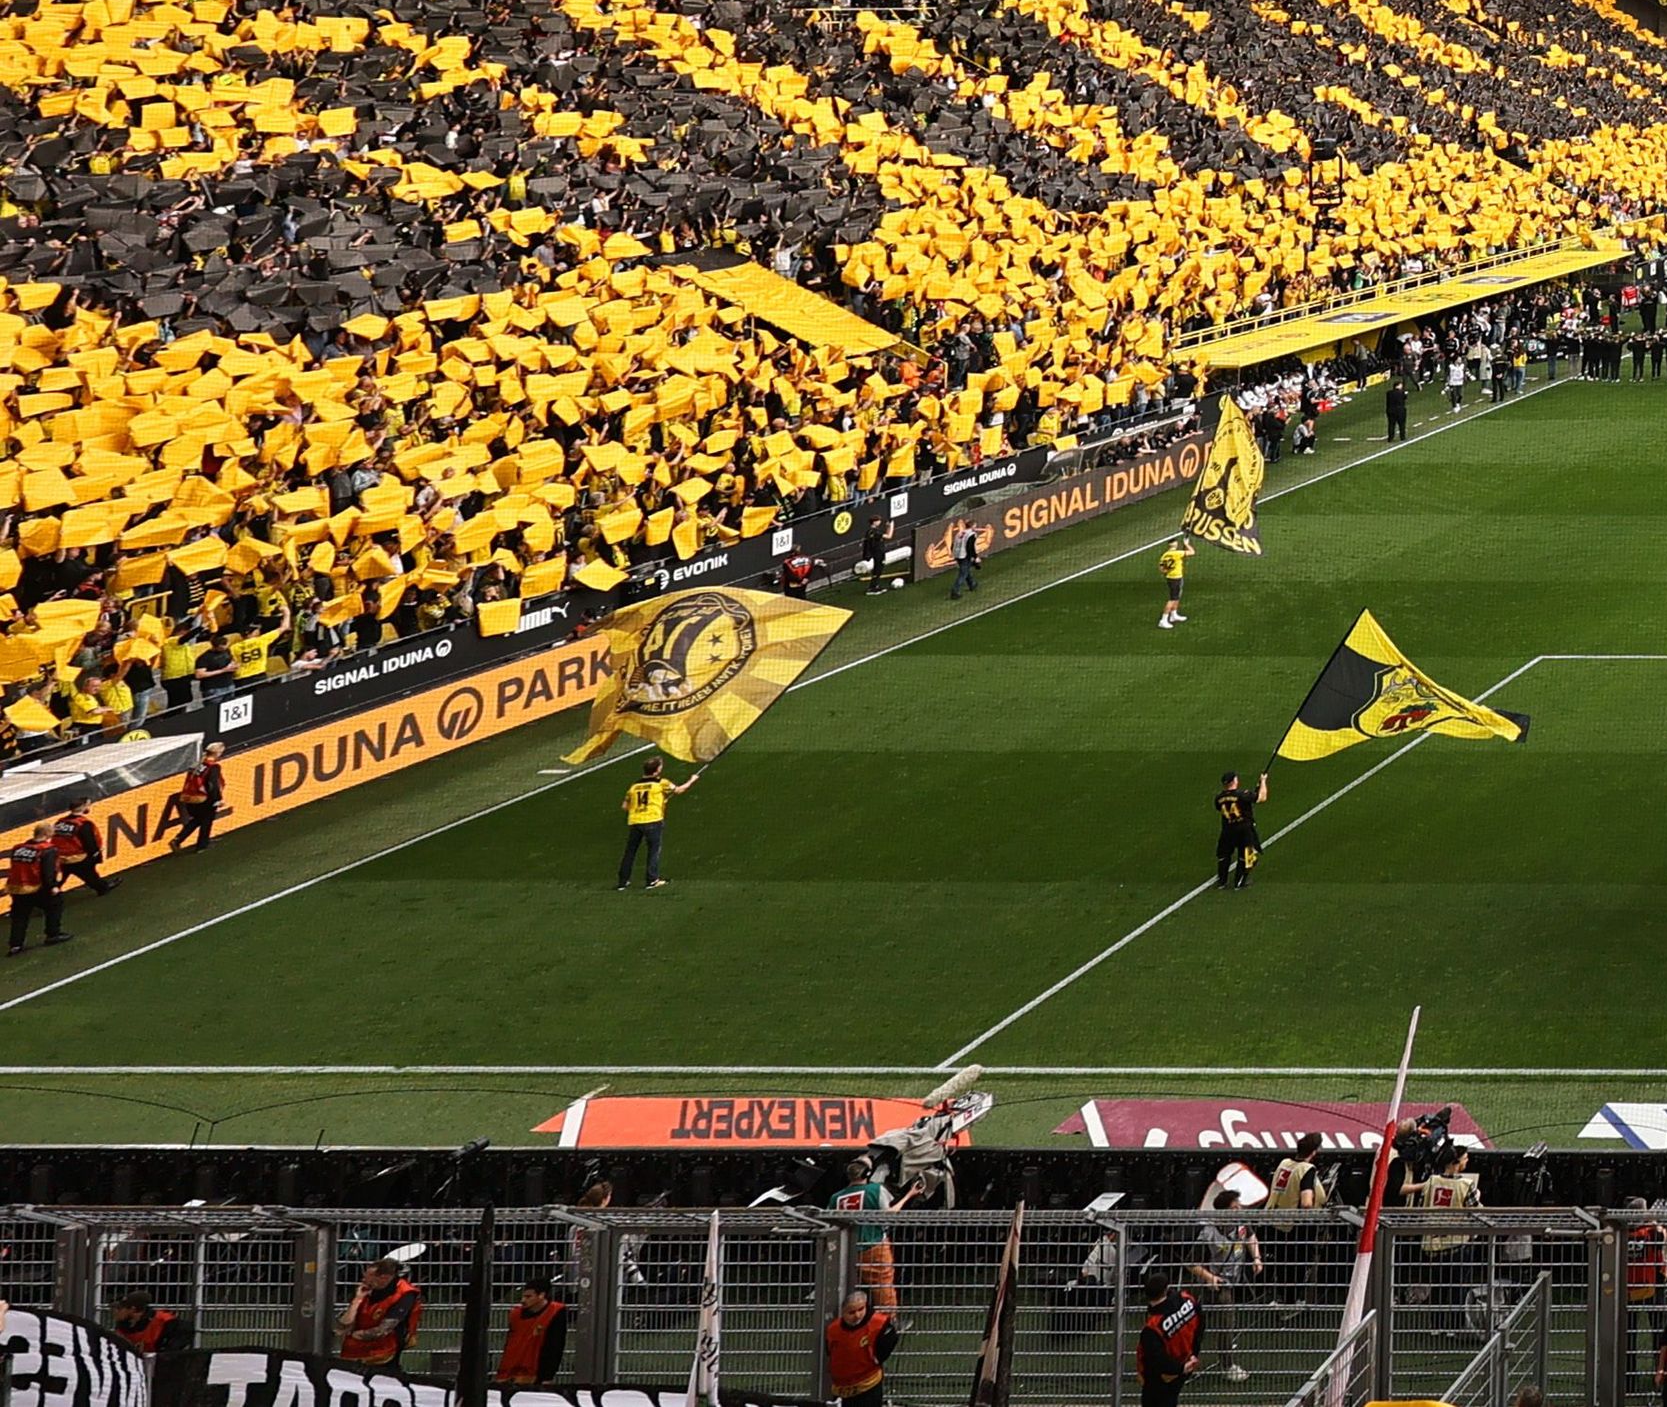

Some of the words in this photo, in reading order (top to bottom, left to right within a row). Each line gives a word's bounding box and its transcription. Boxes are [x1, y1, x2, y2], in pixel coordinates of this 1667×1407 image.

[942, 476, 977, 496] SIGNAL
[979, 469, 1007, 485] IDUNA
[1003, 482, 1099, 539] SIGNAL
[1105, 455, 1176, 504] IDUNA
[775, 533, 790, 547] 1&1
[673, 551, 728, 582] EVONIK
[240, 647, 262, 664] 69
[314, 664, 379, 695] SIGNAL
[382, 647, 434, 674] IDUNA
[223, 703, 248, 722] 1&1
[254, 714, 425, 805] IDUNA
[497, 646, 614, 719] PARK
[636, 790, 650, 807] 14
[1221, 802, 1241, 820] 14
[670, 1099, 798, 1140] EXPERT
[805, 1099, 876, 1140] MEN
